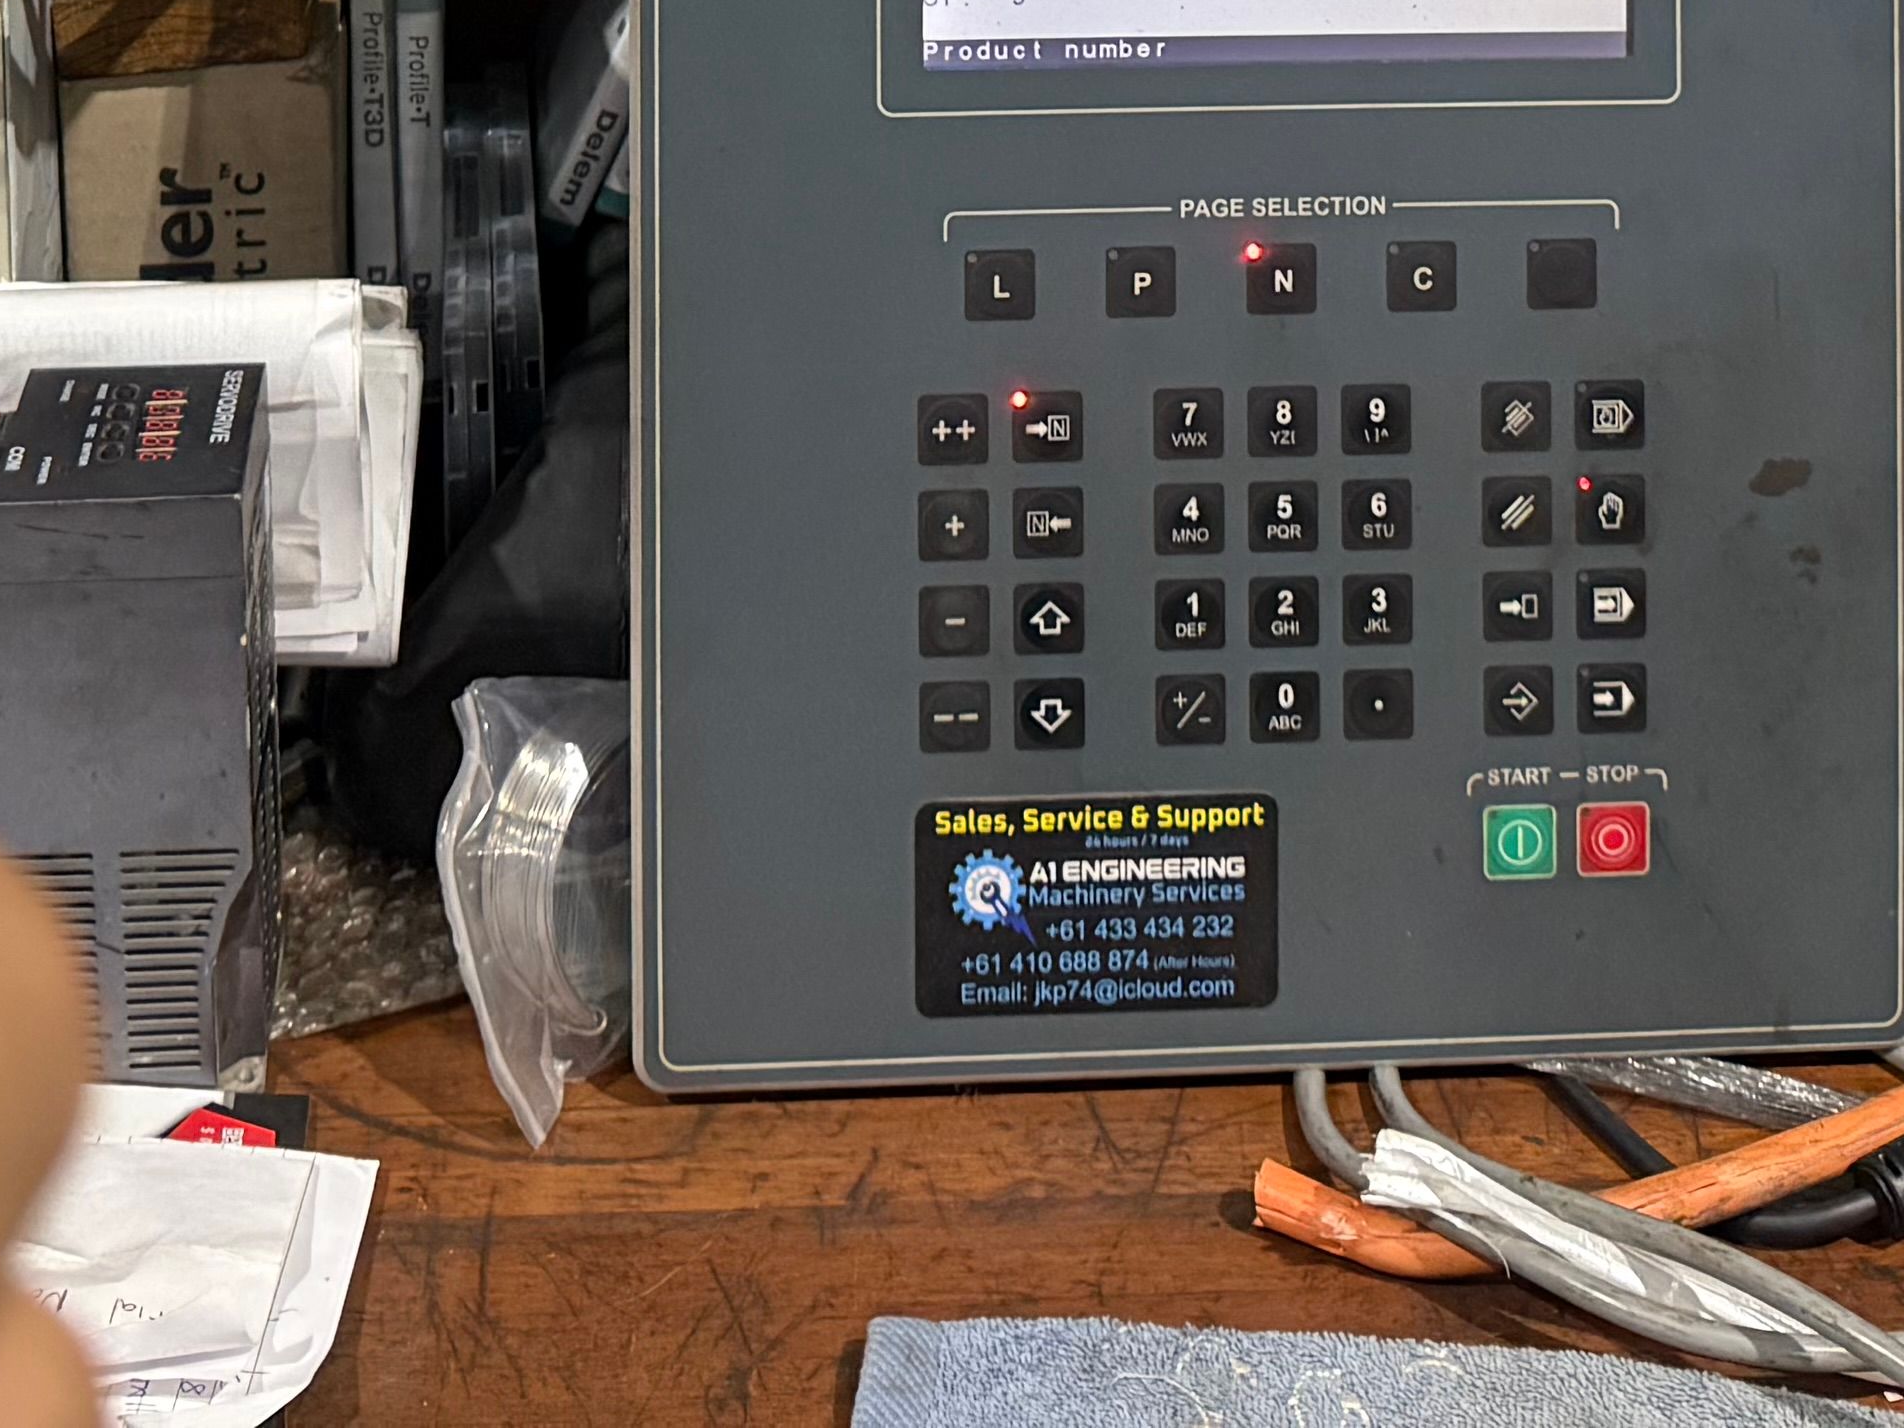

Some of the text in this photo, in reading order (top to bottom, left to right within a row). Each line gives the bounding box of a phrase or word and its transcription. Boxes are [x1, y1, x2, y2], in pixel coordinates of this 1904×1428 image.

[924, 38, 1166, 62] Product number
[561, 108, 618, 207] Delem
[1180, 196, 1386, 219] PAGE SELECTION
[209, 369, 244, 444] SERVODRIVE
[1488, 764, 1639, 785] START STOP
